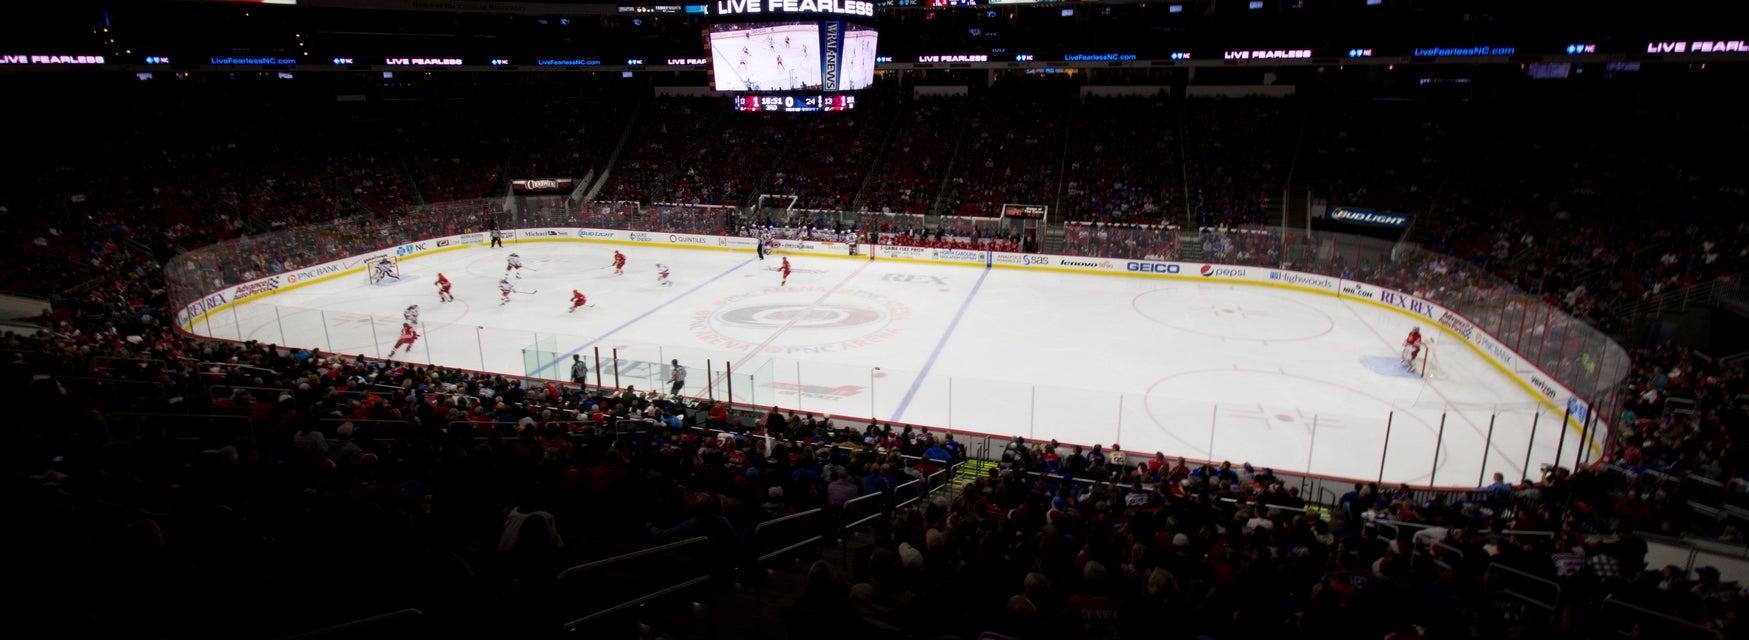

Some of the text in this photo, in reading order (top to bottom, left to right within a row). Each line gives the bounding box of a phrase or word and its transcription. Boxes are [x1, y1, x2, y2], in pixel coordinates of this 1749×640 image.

[717, 0, 873, 17] LIVE FEARLESS
[1414, 46, 1515, 57] LiveFearlessNC.com
[1647, 42, 1688, 53] LIVE
[31, 55, 105, 64] FEARLESS
[1064, 53, 1136, 61] LiveFearlessNC.com
[1224, 50, 1312, 59] LIVE FEARLESS
[211, 57, 296, 65] LiveFearlessNC.com
[827, 54, 838, 90] NEWS
[761, 97, 783, 105] 18:51
[785, 97, 794, 107] 0
[1331, 208, 1406, 226] BUD LIGHT
[578, 229, 595, 238] BUD
[678, 234, 706, 244] QUINTILES
[415, 243, 427, 251] NC
[1060, 259, 1098, 268] lenovo
[1127, 262, 1180, 274] GEICO
[297, 265, 339, 281] PNC BANK
[1215, 267, 1246, 278] pepsi
[1279, 271, 1332, 288] Highwoods
[236, 280, 268, 295] Advance
[205, 293, 226, 311] REX
[1381, 290, 1434, 318] REX REX
[695, 331, 751, 351] ARENA
[786, 327, 902, 354] PNC ARENA
[1531, 376, 1556, 399] verizon
